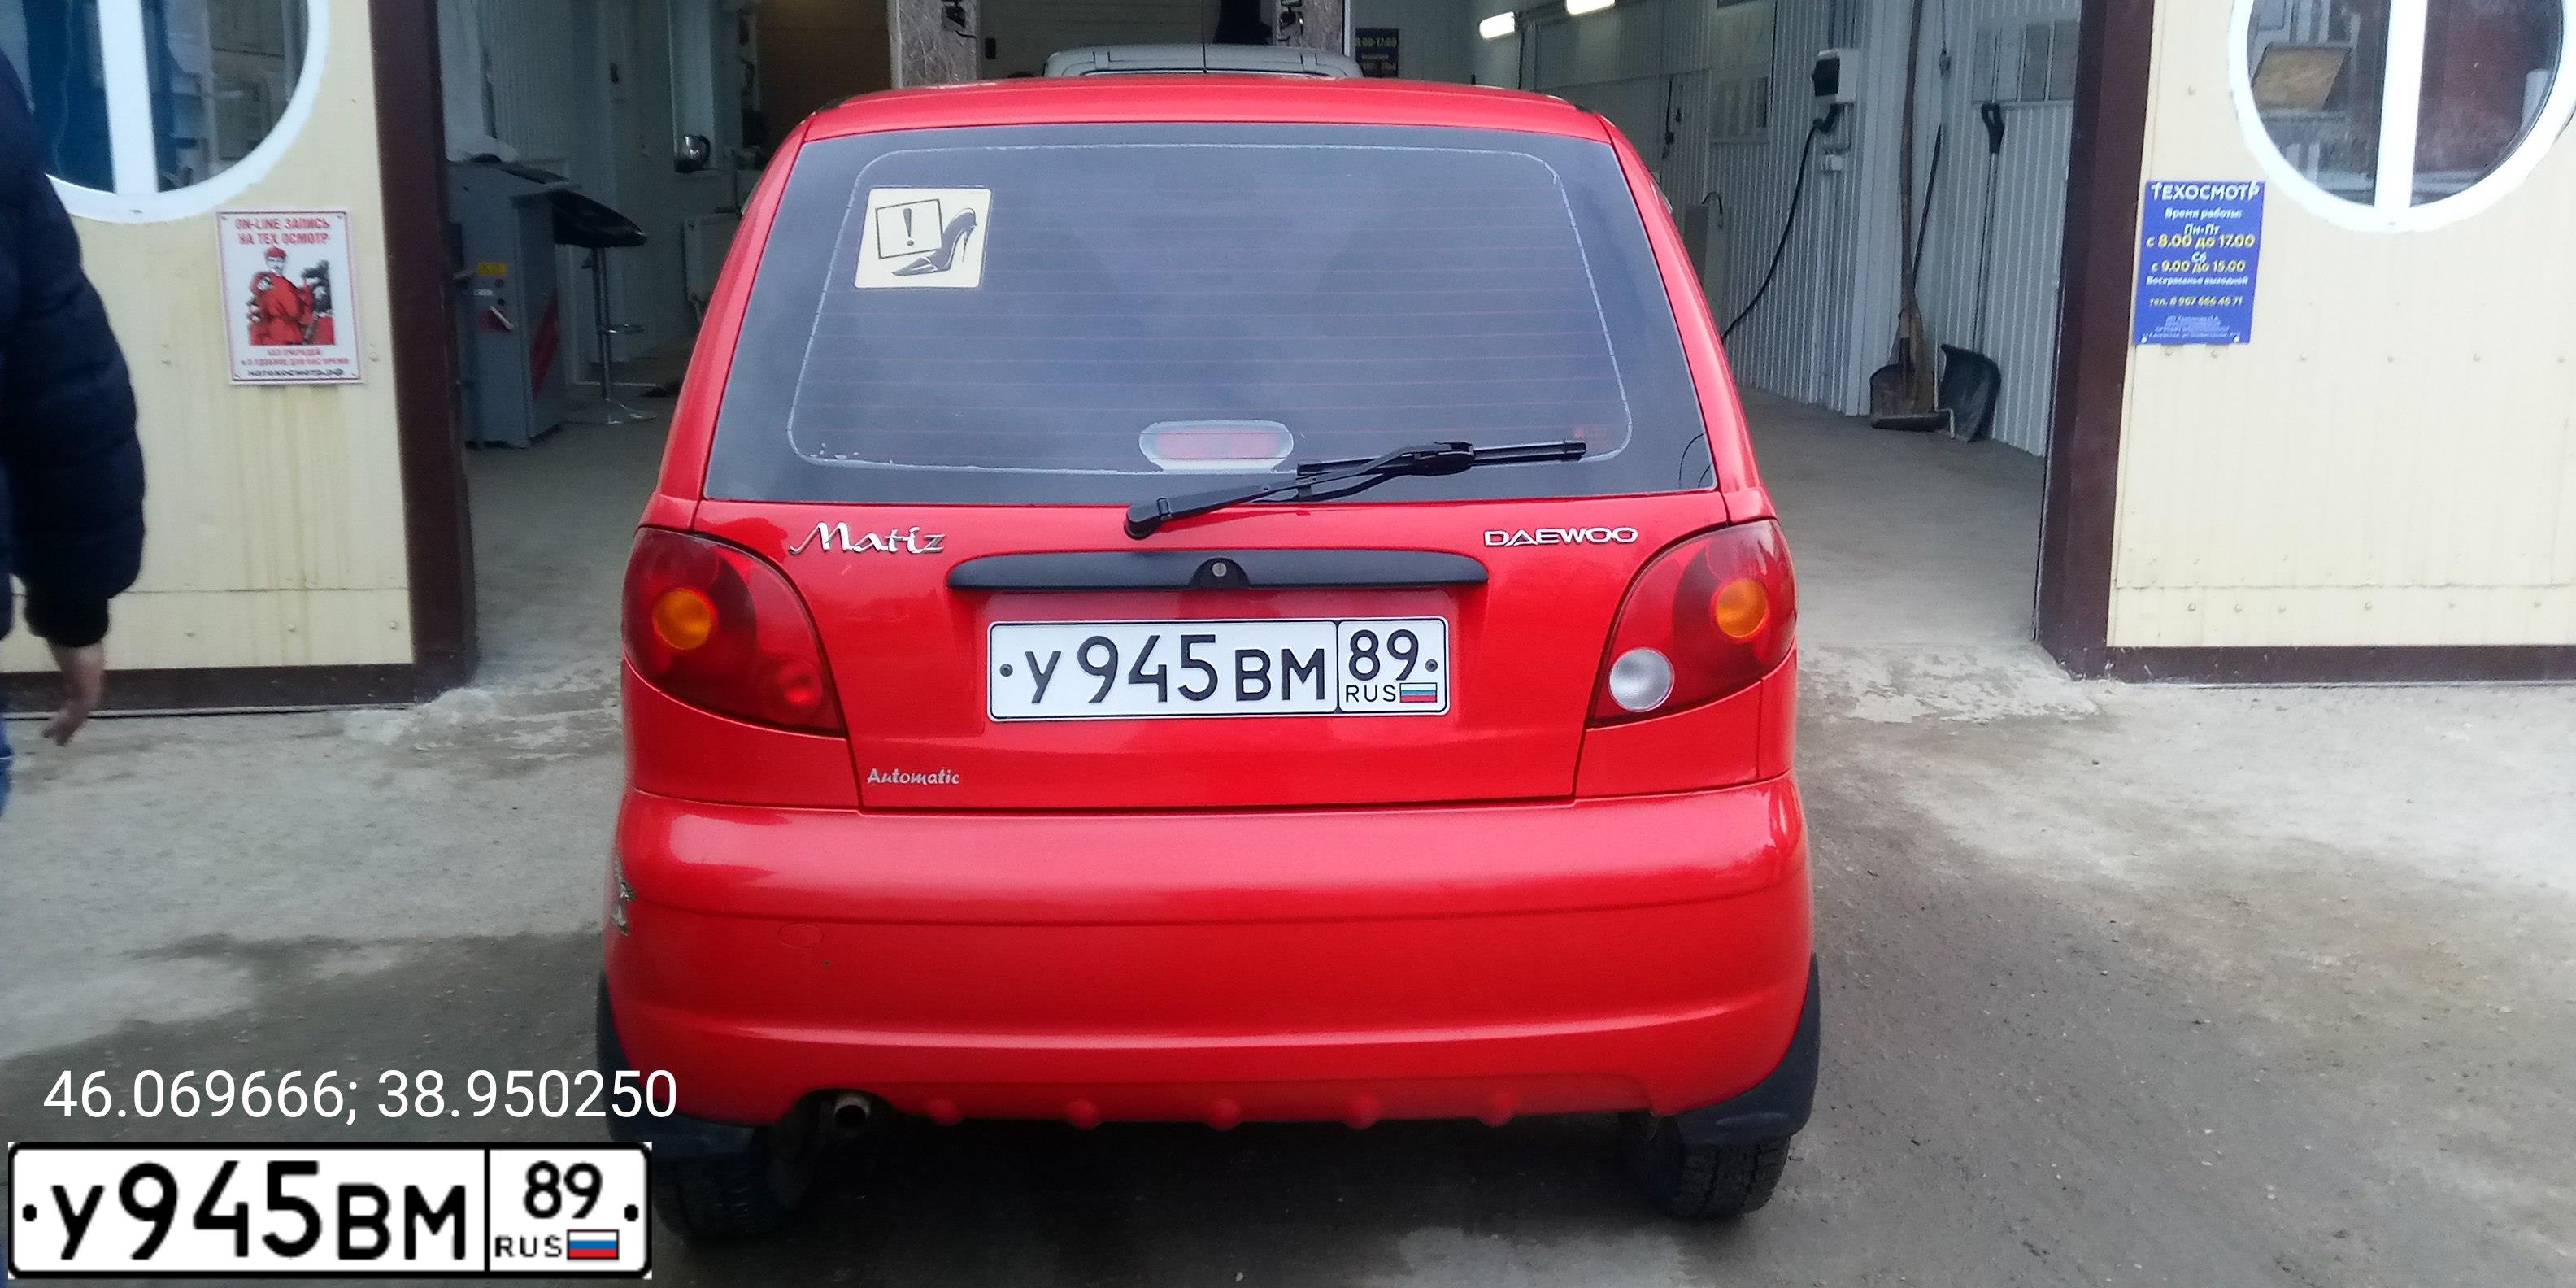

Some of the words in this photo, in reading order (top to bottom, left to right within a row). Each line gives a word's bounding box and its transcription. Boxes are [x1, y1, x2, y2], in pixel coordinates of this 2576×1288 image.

[2151, 181, 2261, 201] ТЕХОСМОТР
[2165, 207, 2200, 220] Время
[234, 218, 280, 229] ON-LINE
[285, 218, 330, 229] ЗАПИСЬ
[2184, 223, 2220, 236] Пн-Пт
[238, 233, 255, 245] НА
[257, 233, 279, 245] ТЕХ
[282, 233, 330, 244] ОСМОТР
[2158, 234, 2192, 247] 8.00
[2195, 237, 2216, 250] до
[2219, 234, 2256, 247] 17.00
[2191, 250, 2207, 263] Сб
[2192, 262, 2209, 274] до
[788, 521, 947, 555] Matiz
[1484, 527, 1638, 547] DAEWOO
[1347, 629, 1420, 681] 89
[1345, 684, 1397, 703] RUS
[867, 767, 959, 785] Automatic
